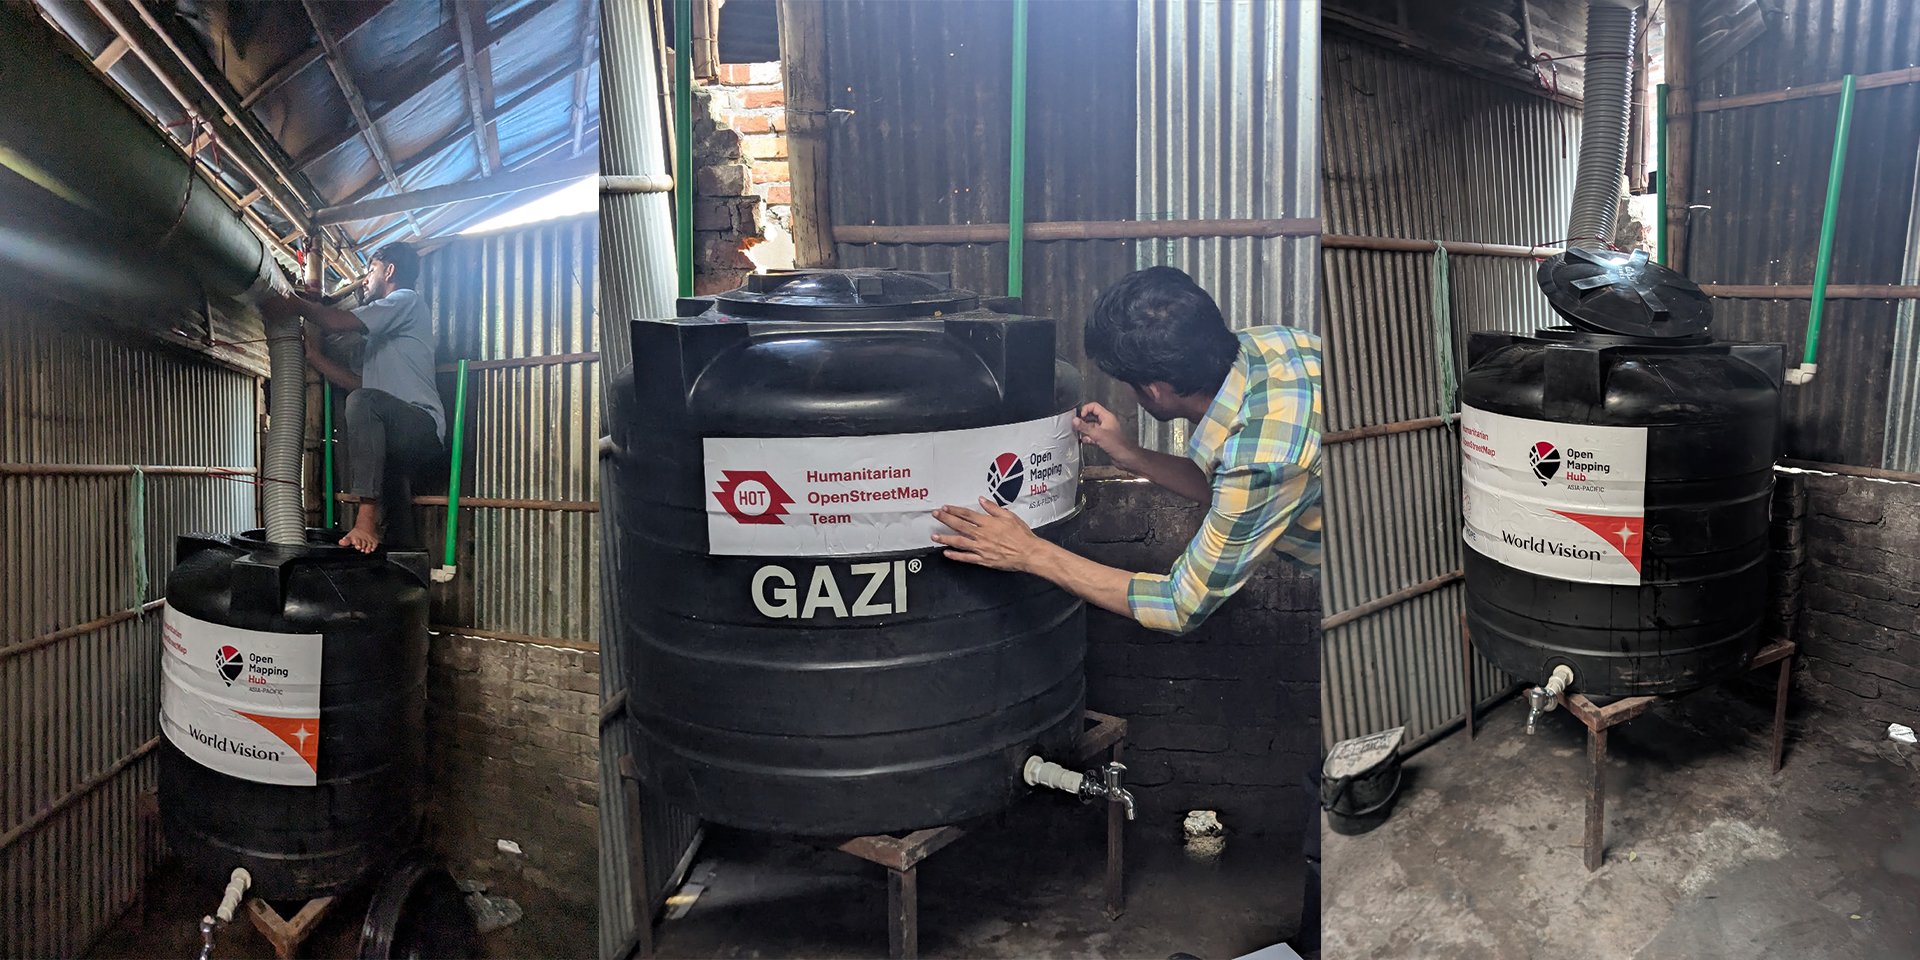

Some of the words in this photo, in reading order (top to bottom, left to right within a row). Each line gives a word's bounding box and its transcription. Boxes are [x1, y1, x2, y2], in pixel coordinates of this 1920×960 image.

[1030, 451, 1052, 467] Open
[1567, 448, 1593, 460] Open
[1030, 463, 1063, 481] Mapping
[1567, 460, 1610, 474] Mapping
[806, 466, 911, 483] Humanitarian
[1566, 471, 1587, 482] Hub
[1030, 482, 1048, 496] Hub
[1567, 484, 1605, 493] ASIA-PACIFIC
[739, 490, 766, 506] HOT
[807, 486, 929, 506] OpenStreetMap
[810, 512, 852, 525] Team
[1502, 529, 1545, 554] World
[249, 652, 273, 664] Open
[249, 663, 289, 678] Mapping
[248, 674, 267, 685] Hub
[189, 723, 227, 752] World
